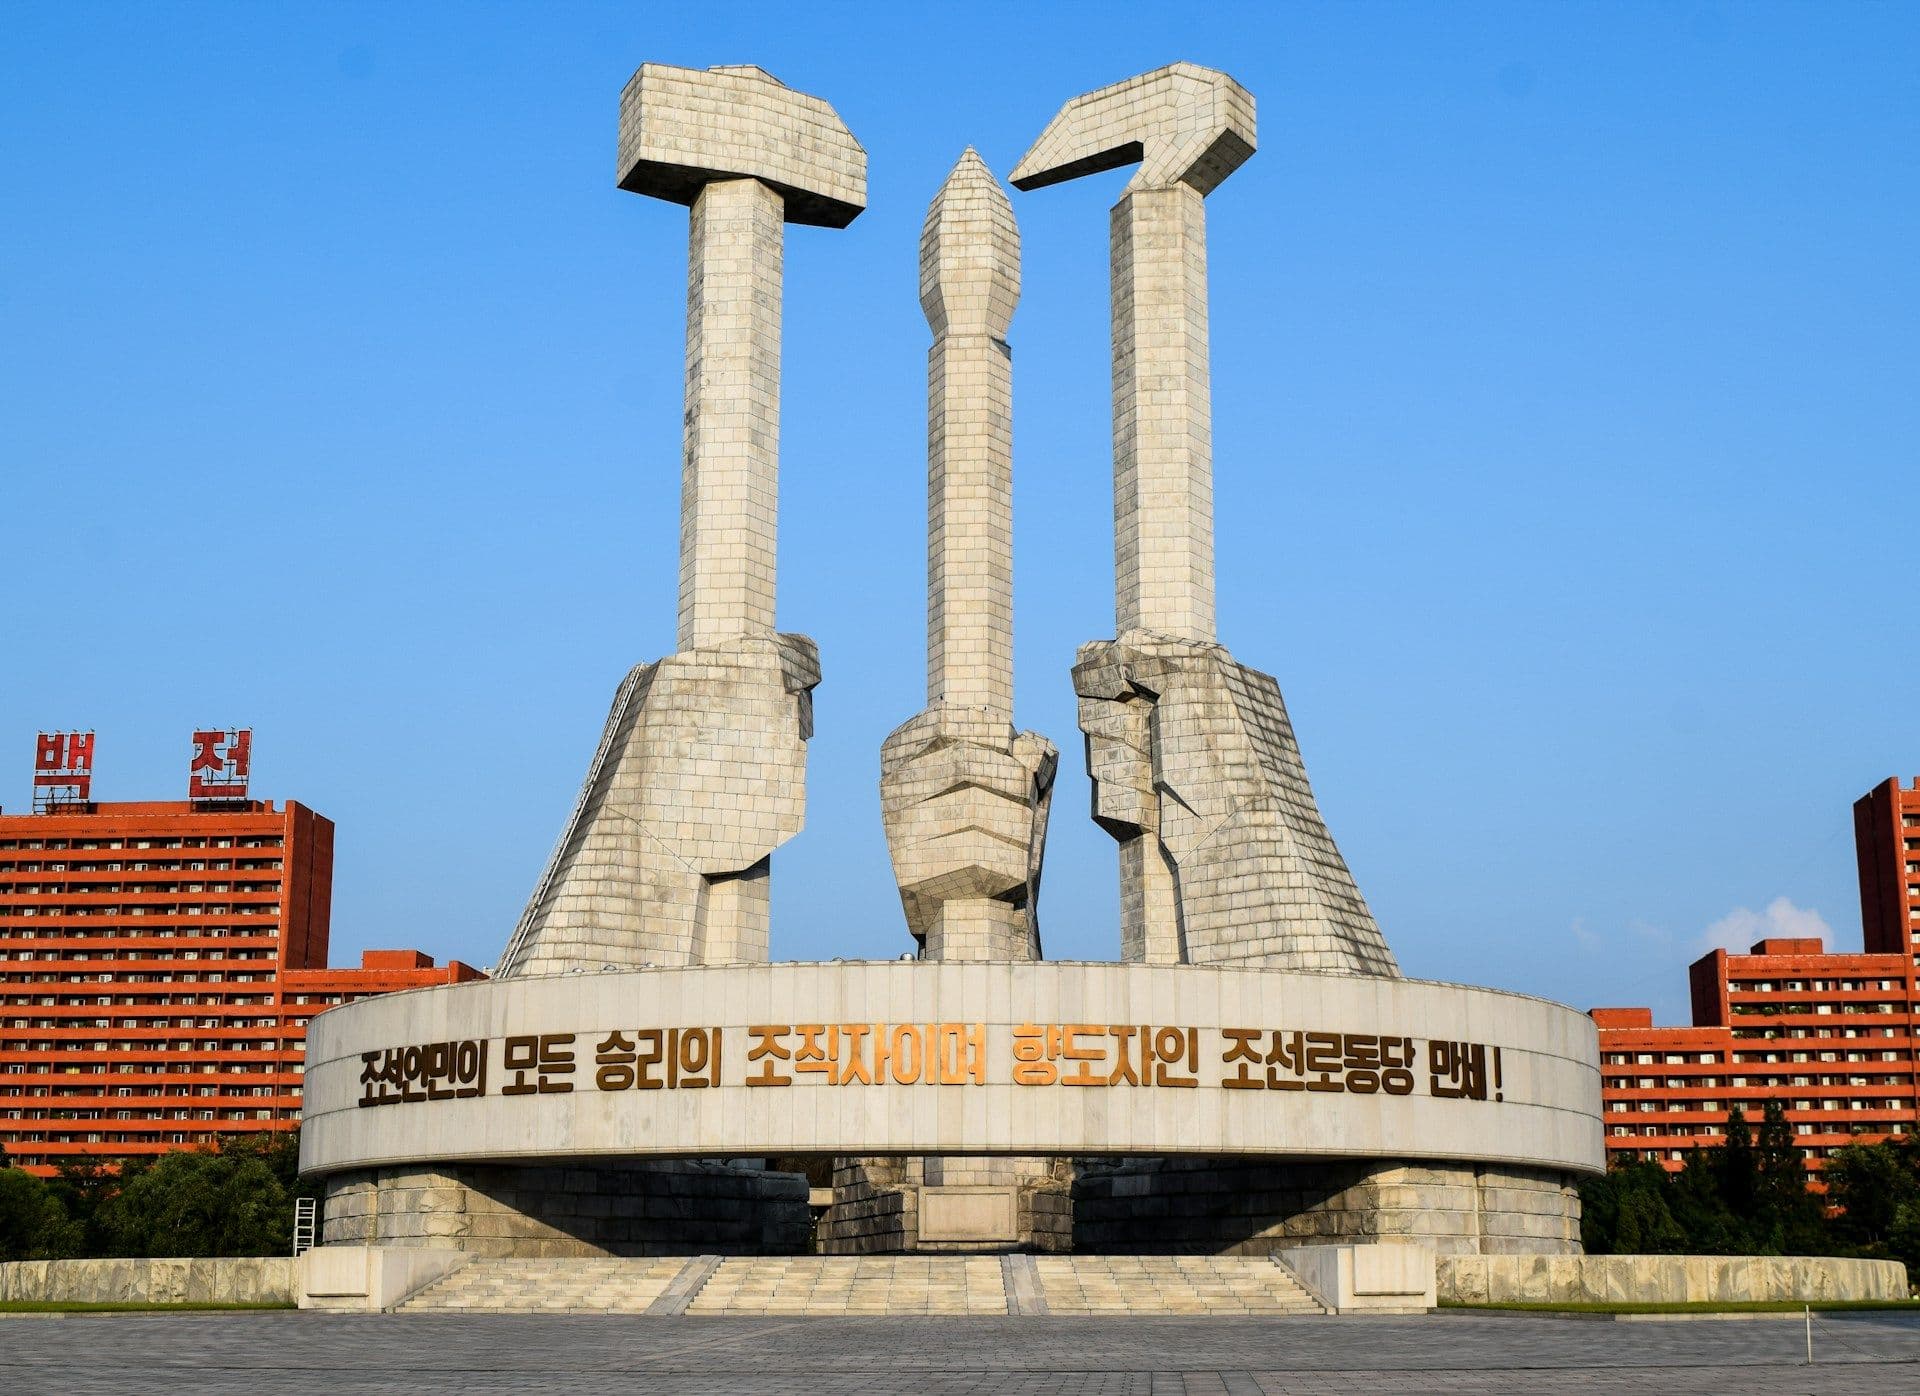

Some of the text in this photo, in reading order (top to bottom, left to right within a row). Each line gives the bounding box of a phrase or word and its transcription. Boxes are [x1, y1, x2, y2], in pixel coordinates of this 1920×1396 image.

[358, 1021, 1503, 1108] 조선인민의 모든 승리의 조직자이며 향도자인 조선로동당 만세!
